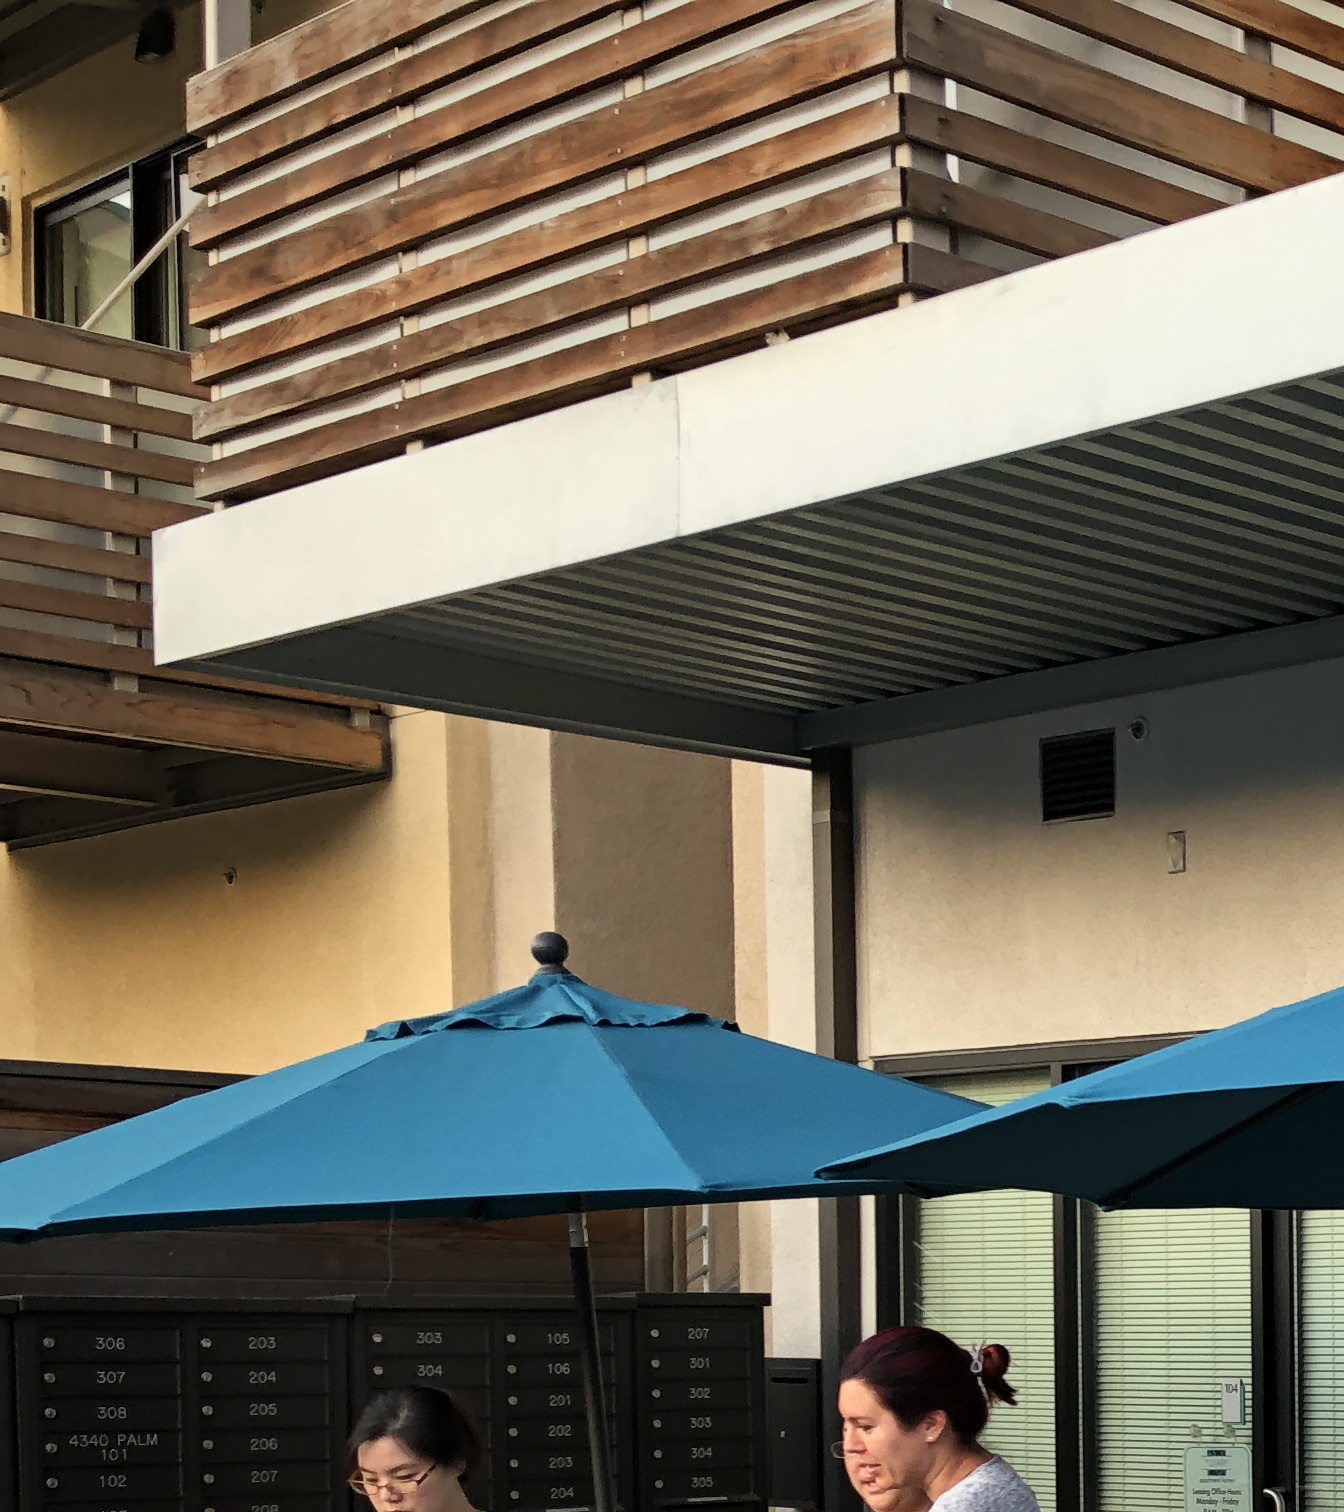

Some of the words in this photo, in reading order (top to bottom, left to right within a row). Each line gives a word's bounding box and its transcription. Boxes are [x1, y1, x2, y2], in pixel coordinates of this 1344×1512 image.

[416, 1332, 443, 1344] 303
[547, 1332, 570, 1345] 105
[687, 1327, 710, 1340] 207
[95, 1337, 126, 1350] 306
[248, 1336, 276, 1350] 203
[548, 1362, 571, 1375] 106
[689, 1357, 710, 1369] 301
[248, 1370, 277, 1384] 204
[417, 1364, 443, 1377] 304
[96, 1371, 126, 1384] 307
[689, 1387, 711, 1399] 302
[1224, 1383, 1238, 1393] 104
[549, 1394, 571, 1407] 201
[97, 1406, 127, 1420] 308
[249, 1403, 278, 1416] 205
[689, 1416, 712, 1429] 303
[548, 1424, 572, 1437] 202
[68, 1434, 109, 1448] 4340
[117, 1433, 158, 1446] PALM
[250, 1437, 278, 1451] 206
[101, 1448, 127, 1461] 101
[691, 1446, 712, 1459] 304
[549, 1456, 573, 1469] 203
[99, 1474, 127, 1488] 102
[250, 1470, 278, 1483] 207
[691, 1476, 714, 1488] 305
[550, 1486, 575, 1499] 204
